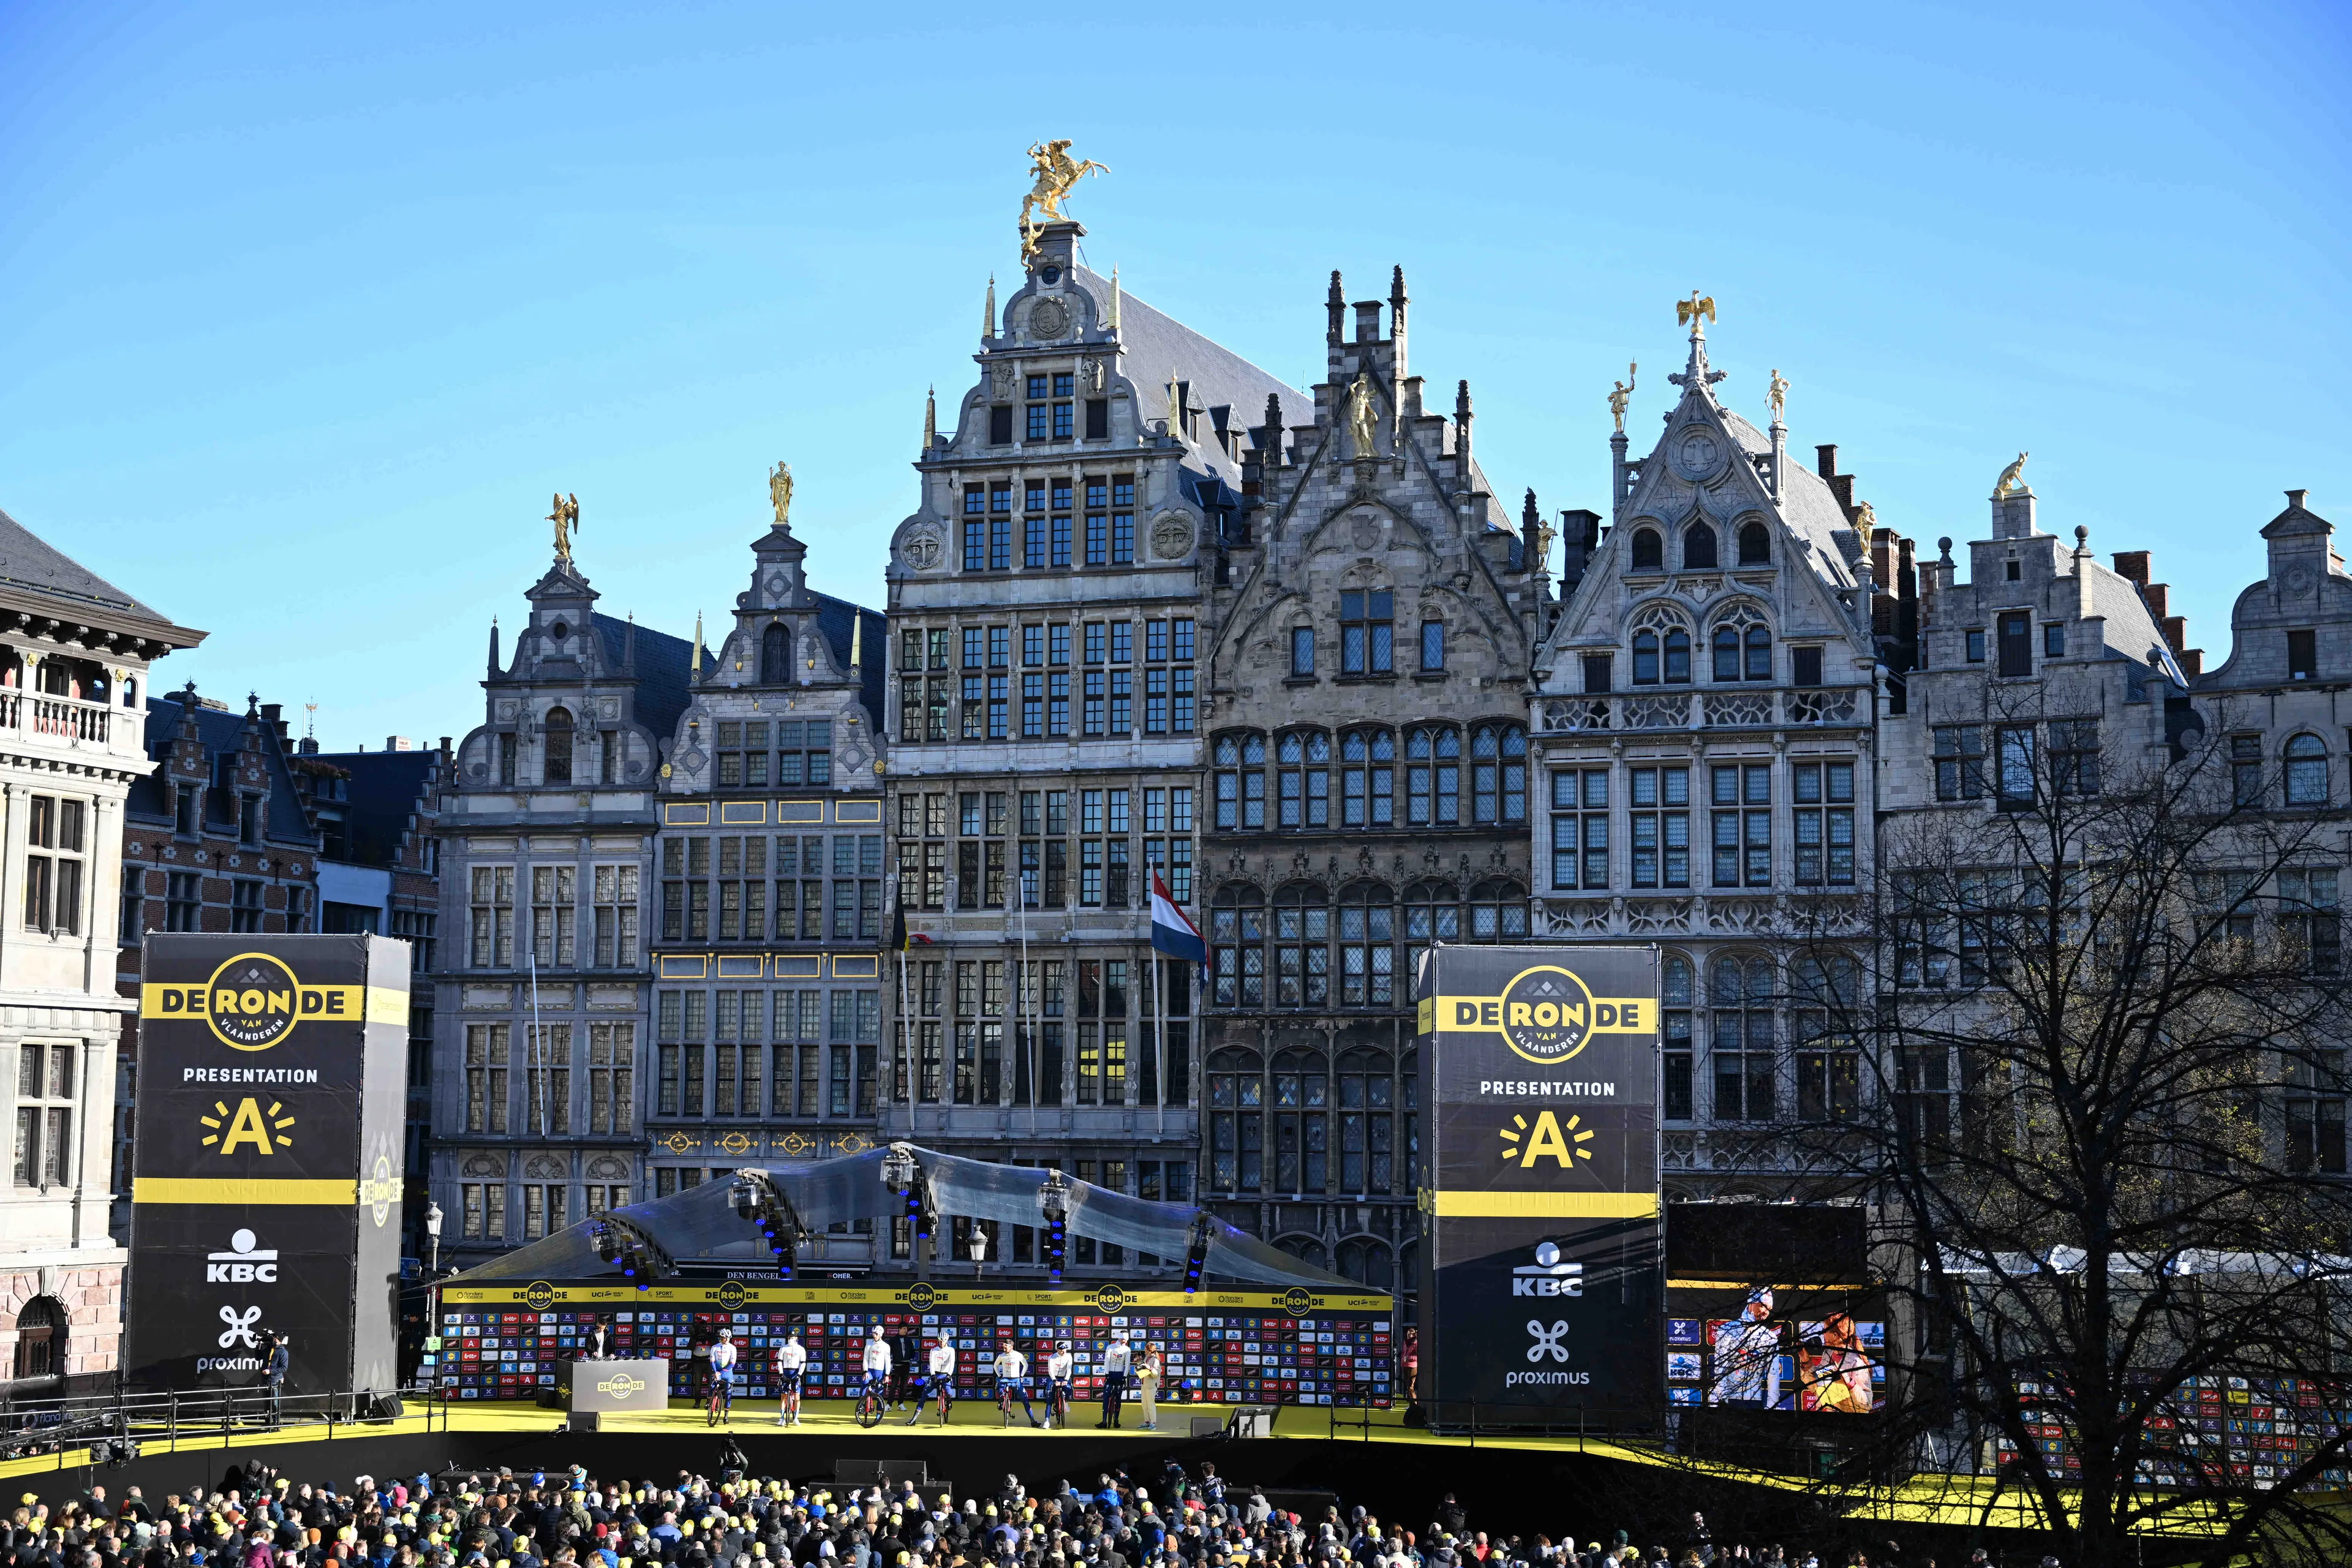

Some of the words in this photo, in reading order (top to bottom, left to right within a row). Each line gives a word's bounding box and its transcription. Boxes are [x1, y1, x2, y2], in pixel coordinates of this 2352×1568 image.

[162, 989, 205, 1012] DE
[215, 989, 290, 1014] RON
[301, 990, 344, 1014] DE
[241, 1019, 262, 1028] VAN
[1455, 1002, 1499, 1025] DE
[1510, 1002, 1584, 1027] RON
[1596, 1004, 1639, 1027] DE
[221, 1018, 284, 1041] VLAANDEREN
[1515, 1031, 1579, 1054] VLAANDEREN
[184, 1068, 317, 1083] PRESENTATION
[1481, 1081, 1615, 1096] PRESENTATION
[220, 1098, 273, 1155] A
[1520, 1111, 1573, 1167] A
[365, 1185, 373, 1201] DE
[390, 1182, 398, 1198] DE
[207, 1264, 277, 1283] KBC
[1513, 1278, 1582, 1297] KBC
[1506, 1371, 1589, 1387] proximus
